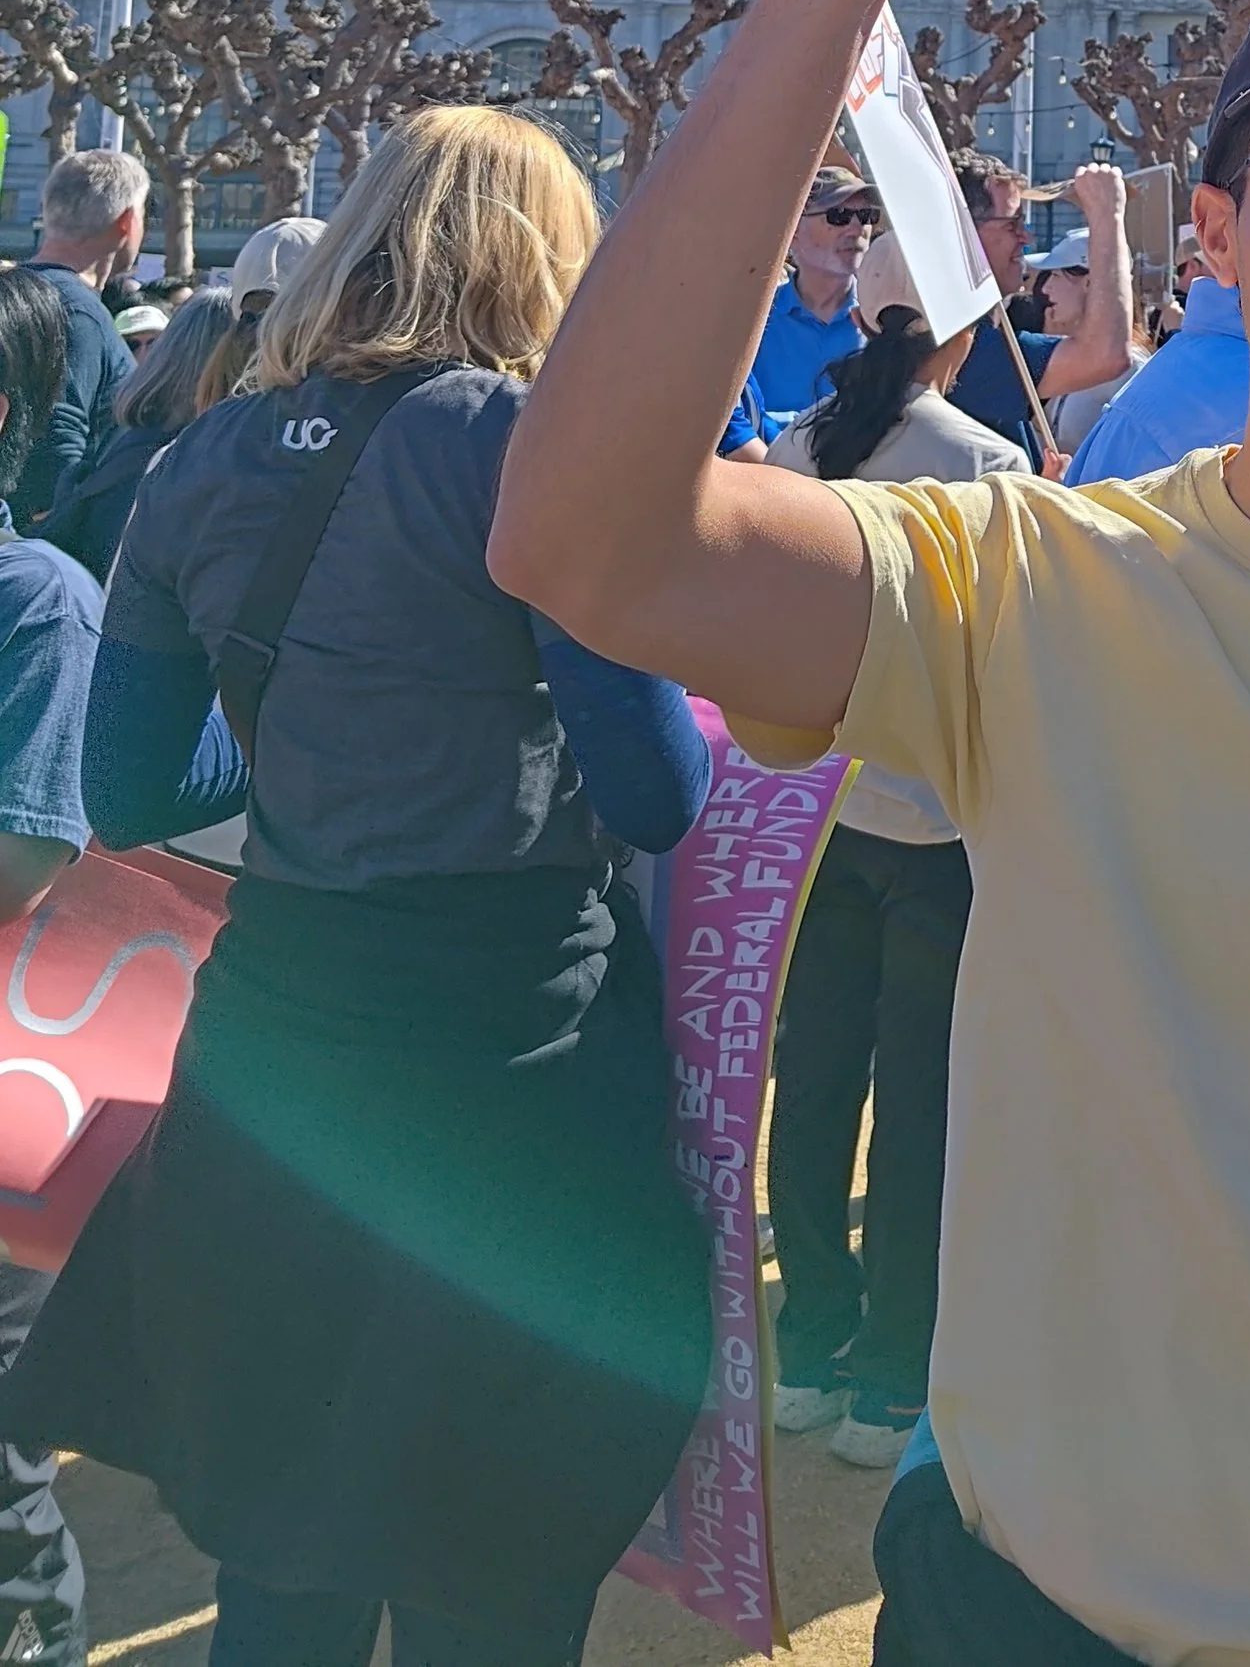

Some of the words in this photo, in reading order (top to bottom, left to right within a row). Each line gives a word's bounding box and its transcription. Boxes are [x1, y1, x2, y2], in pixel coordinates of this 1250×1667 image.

[677, 926, 728, 1041] AND
[717, 896, 786, 1078] FEDERAL
[711, 1097, 747, 1318] WITHOUT
[721, 1335, 755, 1401] GO
[725, 1418, 756, 1494] WE
[691, 1436, 725, 1597] WHERE
[733, 1510, 764, 1621] WILL
